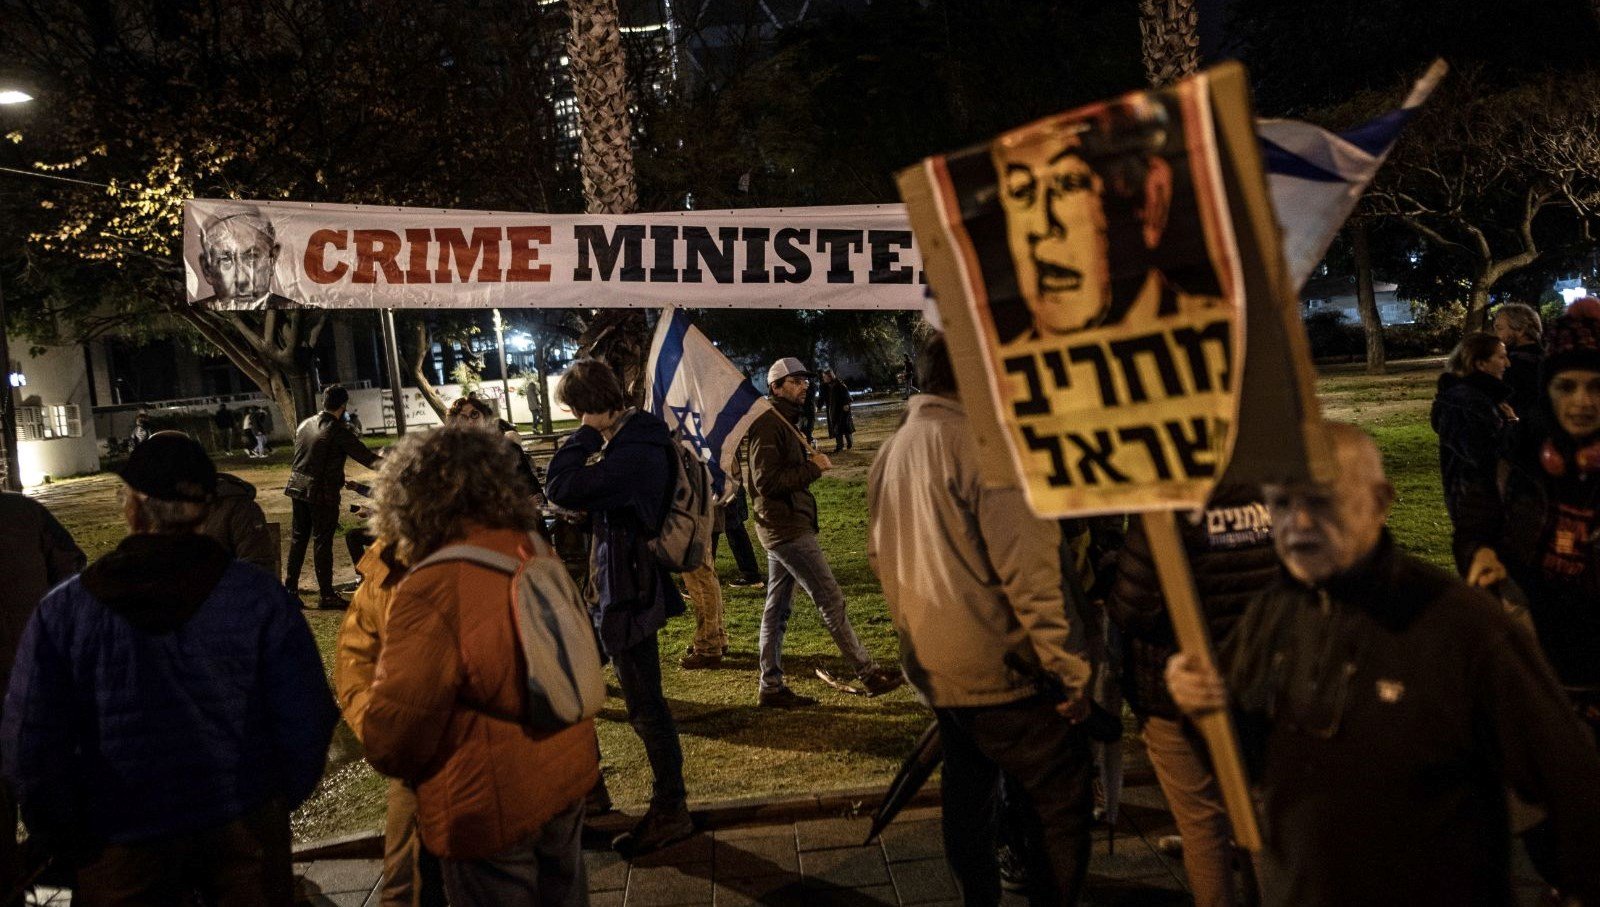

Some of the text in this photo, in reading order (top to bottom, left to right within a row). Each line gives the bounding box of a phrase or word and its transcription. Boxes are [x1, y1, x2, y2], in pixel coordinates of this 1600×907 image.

[303, 224, 927, 285] CRIME MINISTE
[1004, 319, 1231, 418] מחריב
